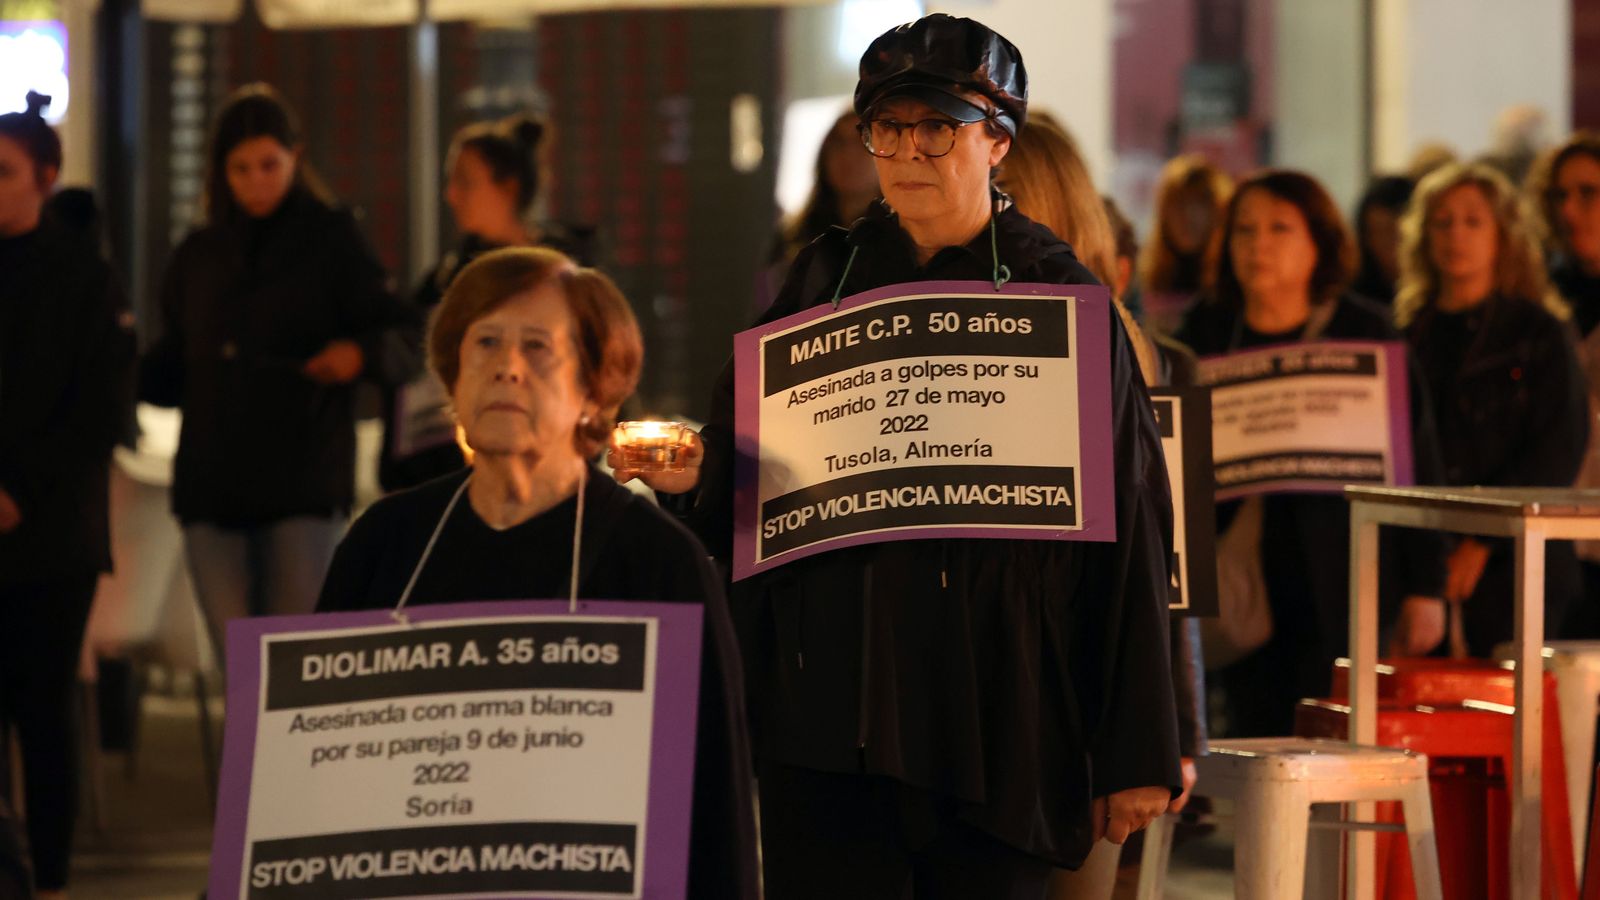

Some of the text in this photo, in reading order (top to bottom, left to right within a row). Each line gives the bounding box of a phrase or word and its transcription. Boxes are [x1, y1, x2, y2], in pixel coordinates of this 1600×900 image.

[790, 312, 1032, 366] MAITE C.P. 50 años
[787, 360, 1038, 408] Asesinada a golpes por su
[813, 387, 1005, 425] marido 27 de mayo
[880, 414, 929, 435] 2022
[825, 439, 993, 473] Tusola, Almería
[764, 484, 1072, 539] STOP VIOLENCIA MACHISTA
[301, 638, 619, 681] DIOLIMAR A. 35 años
[288, 694, 613, 734] Asesinada con arma blanca
[311, 728, 584, 767] por su pareja 9 de junio
[413, 763, 470, 785] 2022
[405, 795, 473, 818] Soria
[252, 843, 632, 888] STOP VIOLENCIA MACHISTA
